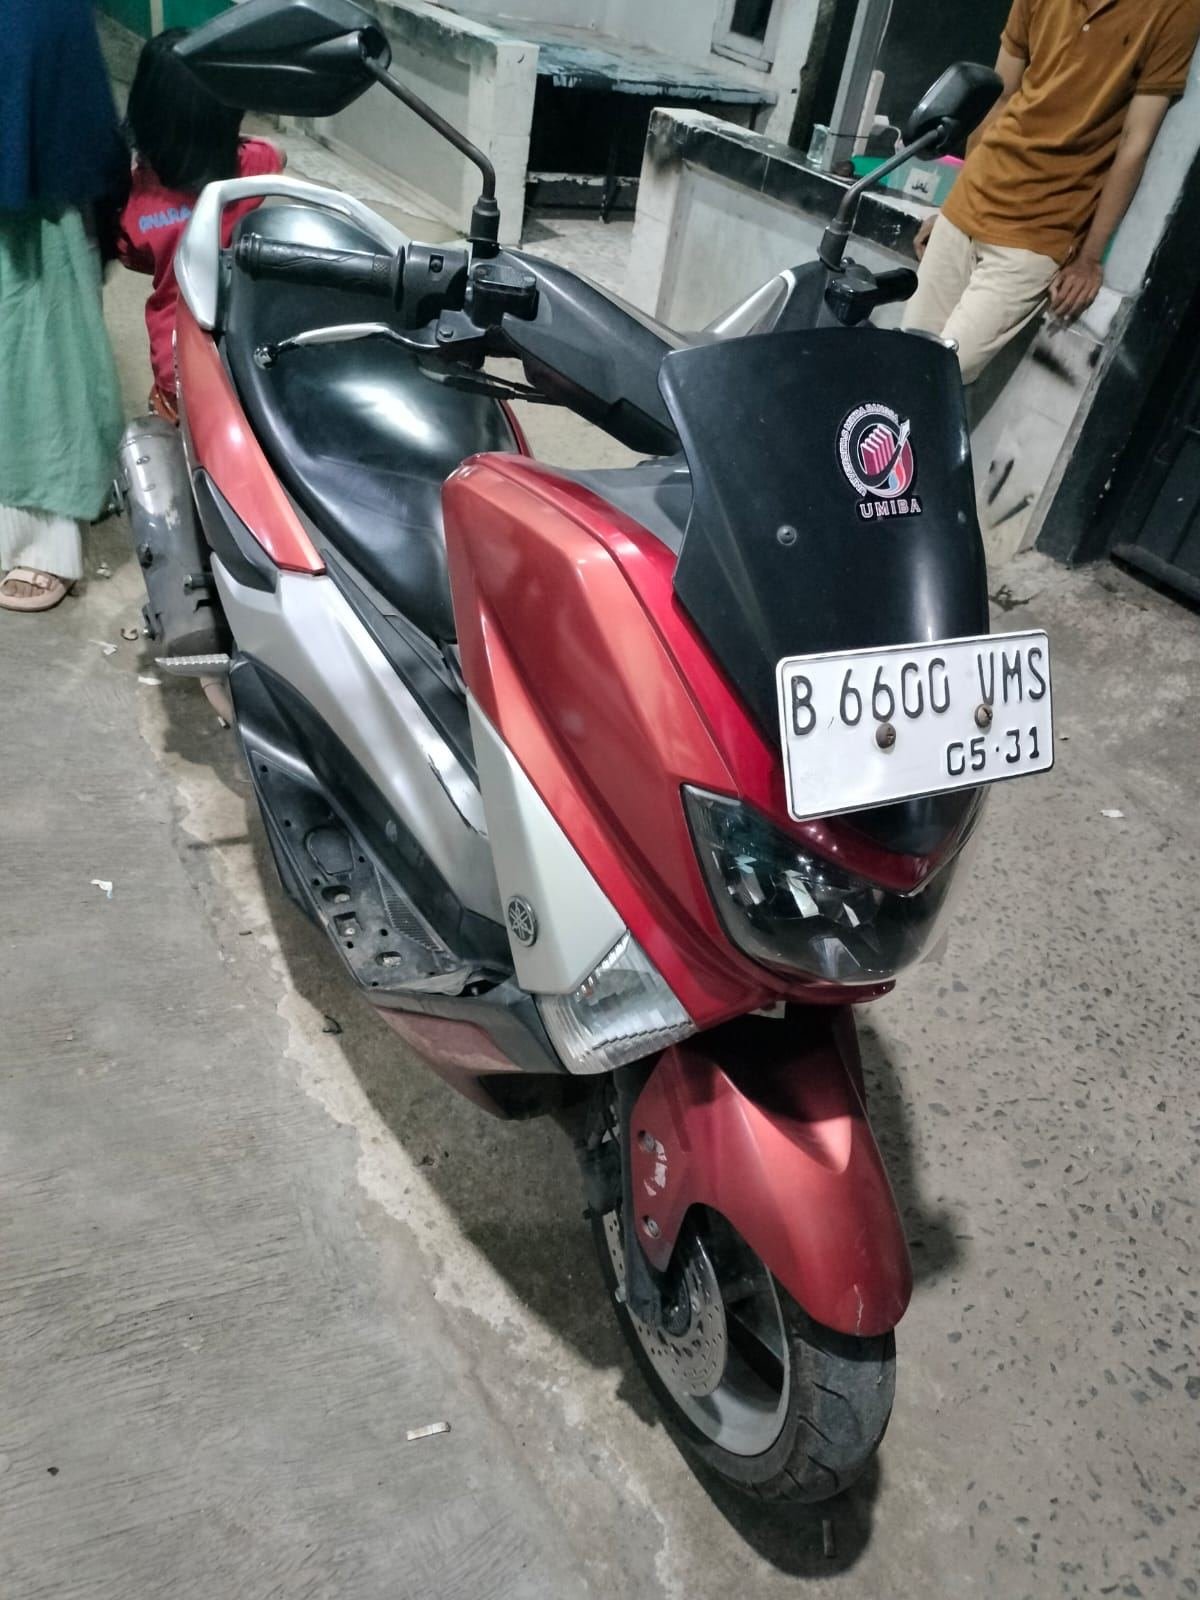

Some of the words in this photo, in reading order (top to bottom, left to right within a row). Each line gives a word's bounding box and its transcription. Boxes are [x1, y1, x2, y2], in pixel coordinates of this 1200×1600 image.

[860, 498, 921, 518] UMIBA
[791, 675, 816, 736] B
[839, 658, 951, 726] 6600
[977, 647, 1047, 706] VMS
